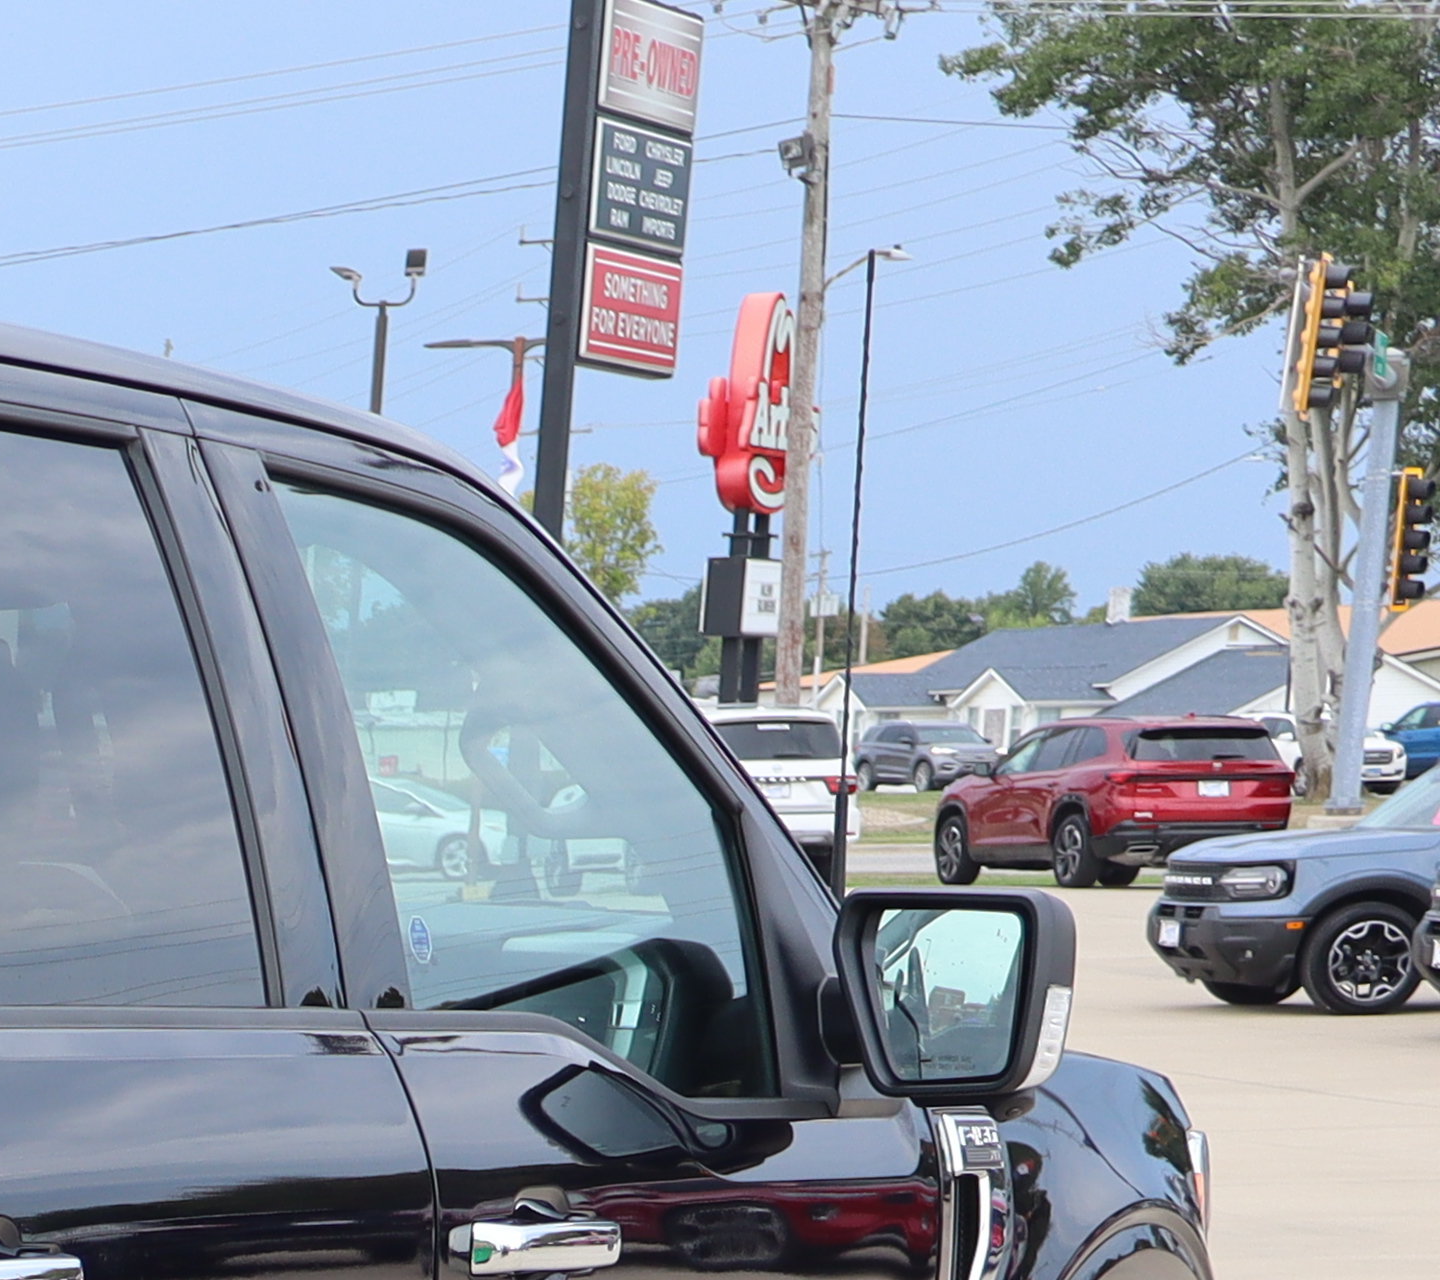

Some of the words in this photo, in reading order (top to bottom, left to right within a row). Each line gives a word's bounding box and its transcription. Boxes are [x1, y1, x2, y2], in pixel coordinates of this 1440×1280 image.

[611, 26, 697, 98] PRE-OWNED
[613, 132, 637, 154] FORD
[645, 140, 685, 167] CHRYSLER
[606, 155, 641, 180] LINCOLN
[654, 168, 673, 188] JEEP
[607, 181, 637, 205] DODGE
[640, 189, 683, 216] CHEVROLET
[610, 208, 630, 229] RAM
[642, 216, 675, 240] IMPORTS
[604, 272, 668, 310] SOMETHING
[592, 306, 616, 335] FOR
[618, 312, 675, 348] EVERYONE
